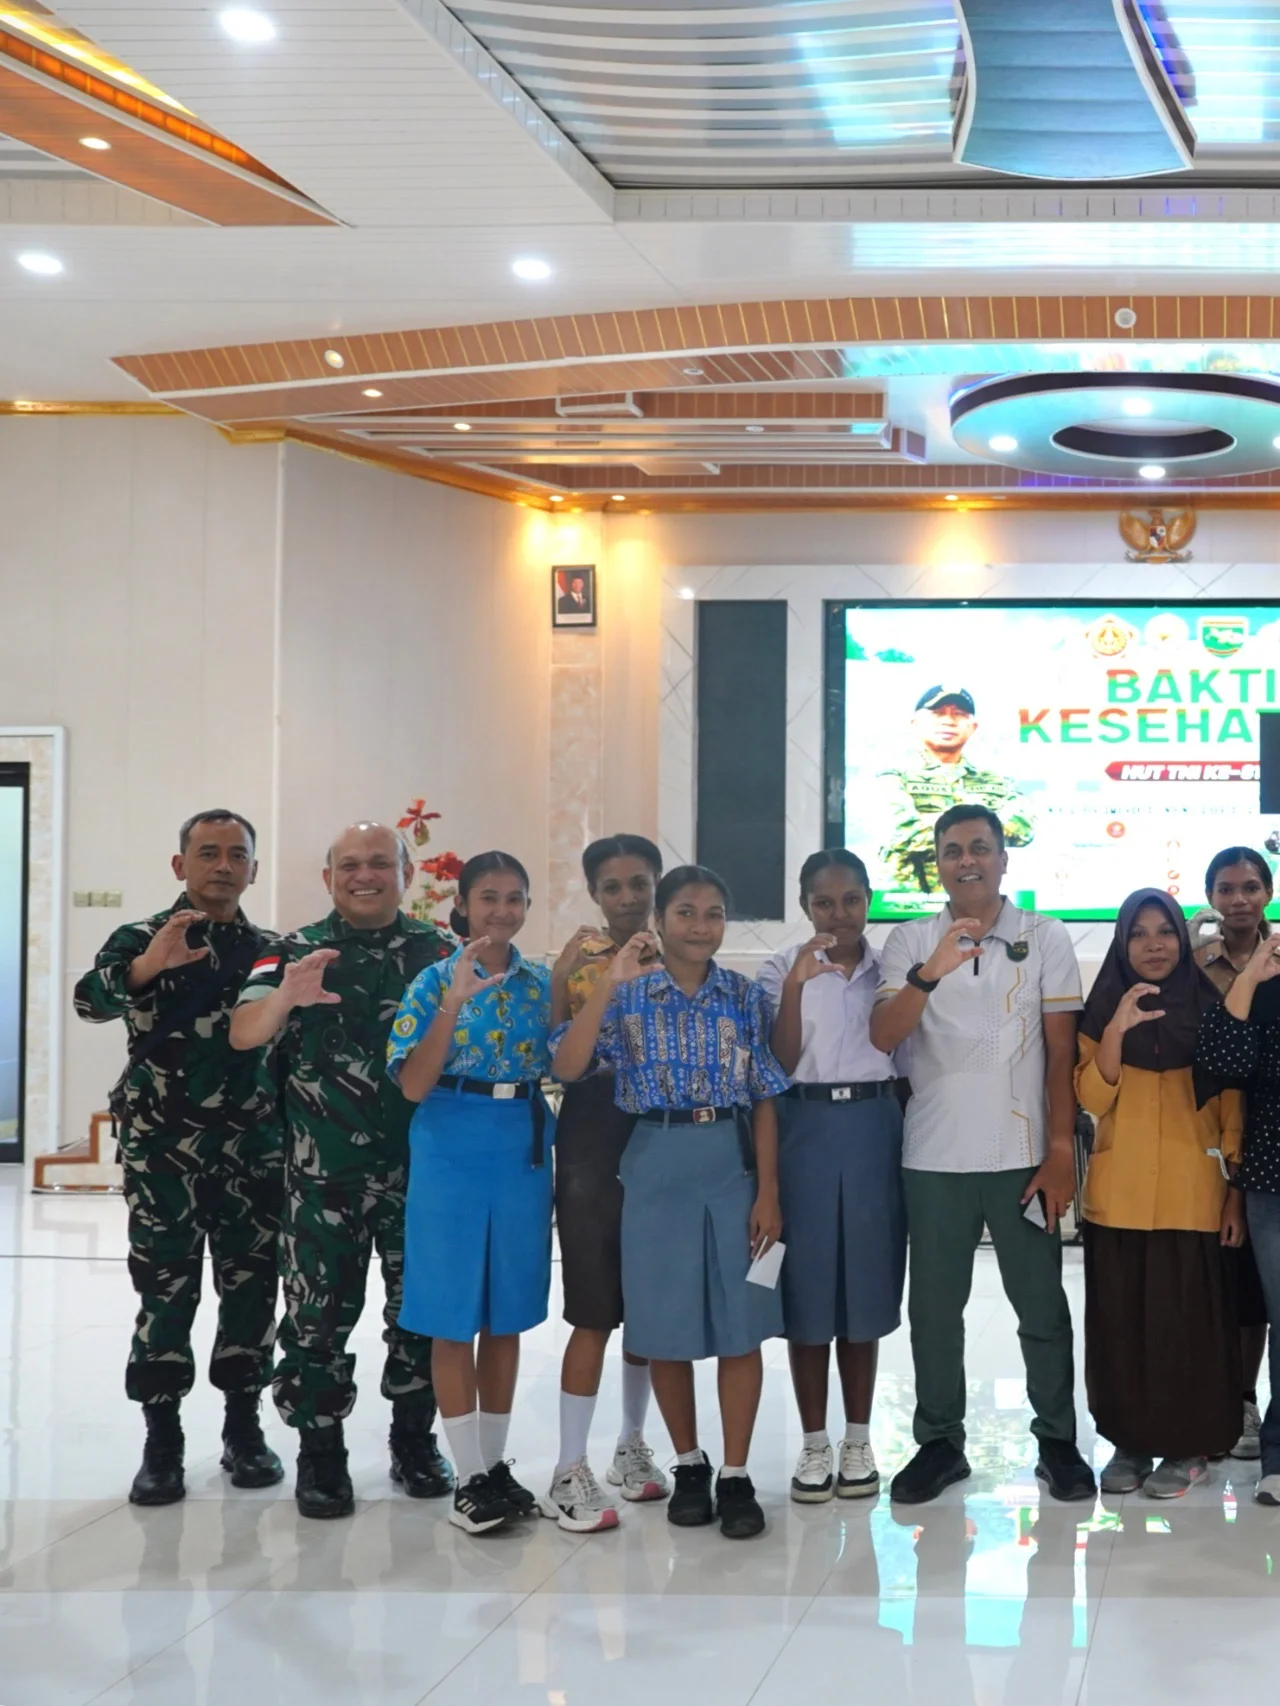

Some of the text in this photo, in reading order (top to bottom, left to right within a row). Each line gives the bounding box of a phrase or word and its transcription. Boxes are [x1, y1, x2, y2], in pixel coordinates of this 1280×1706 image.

[1106, 669, 1276, 703] BAKTI
[1121, 764, 1165, 780] HUT
[1166, 764, 1202, 780] TNI
